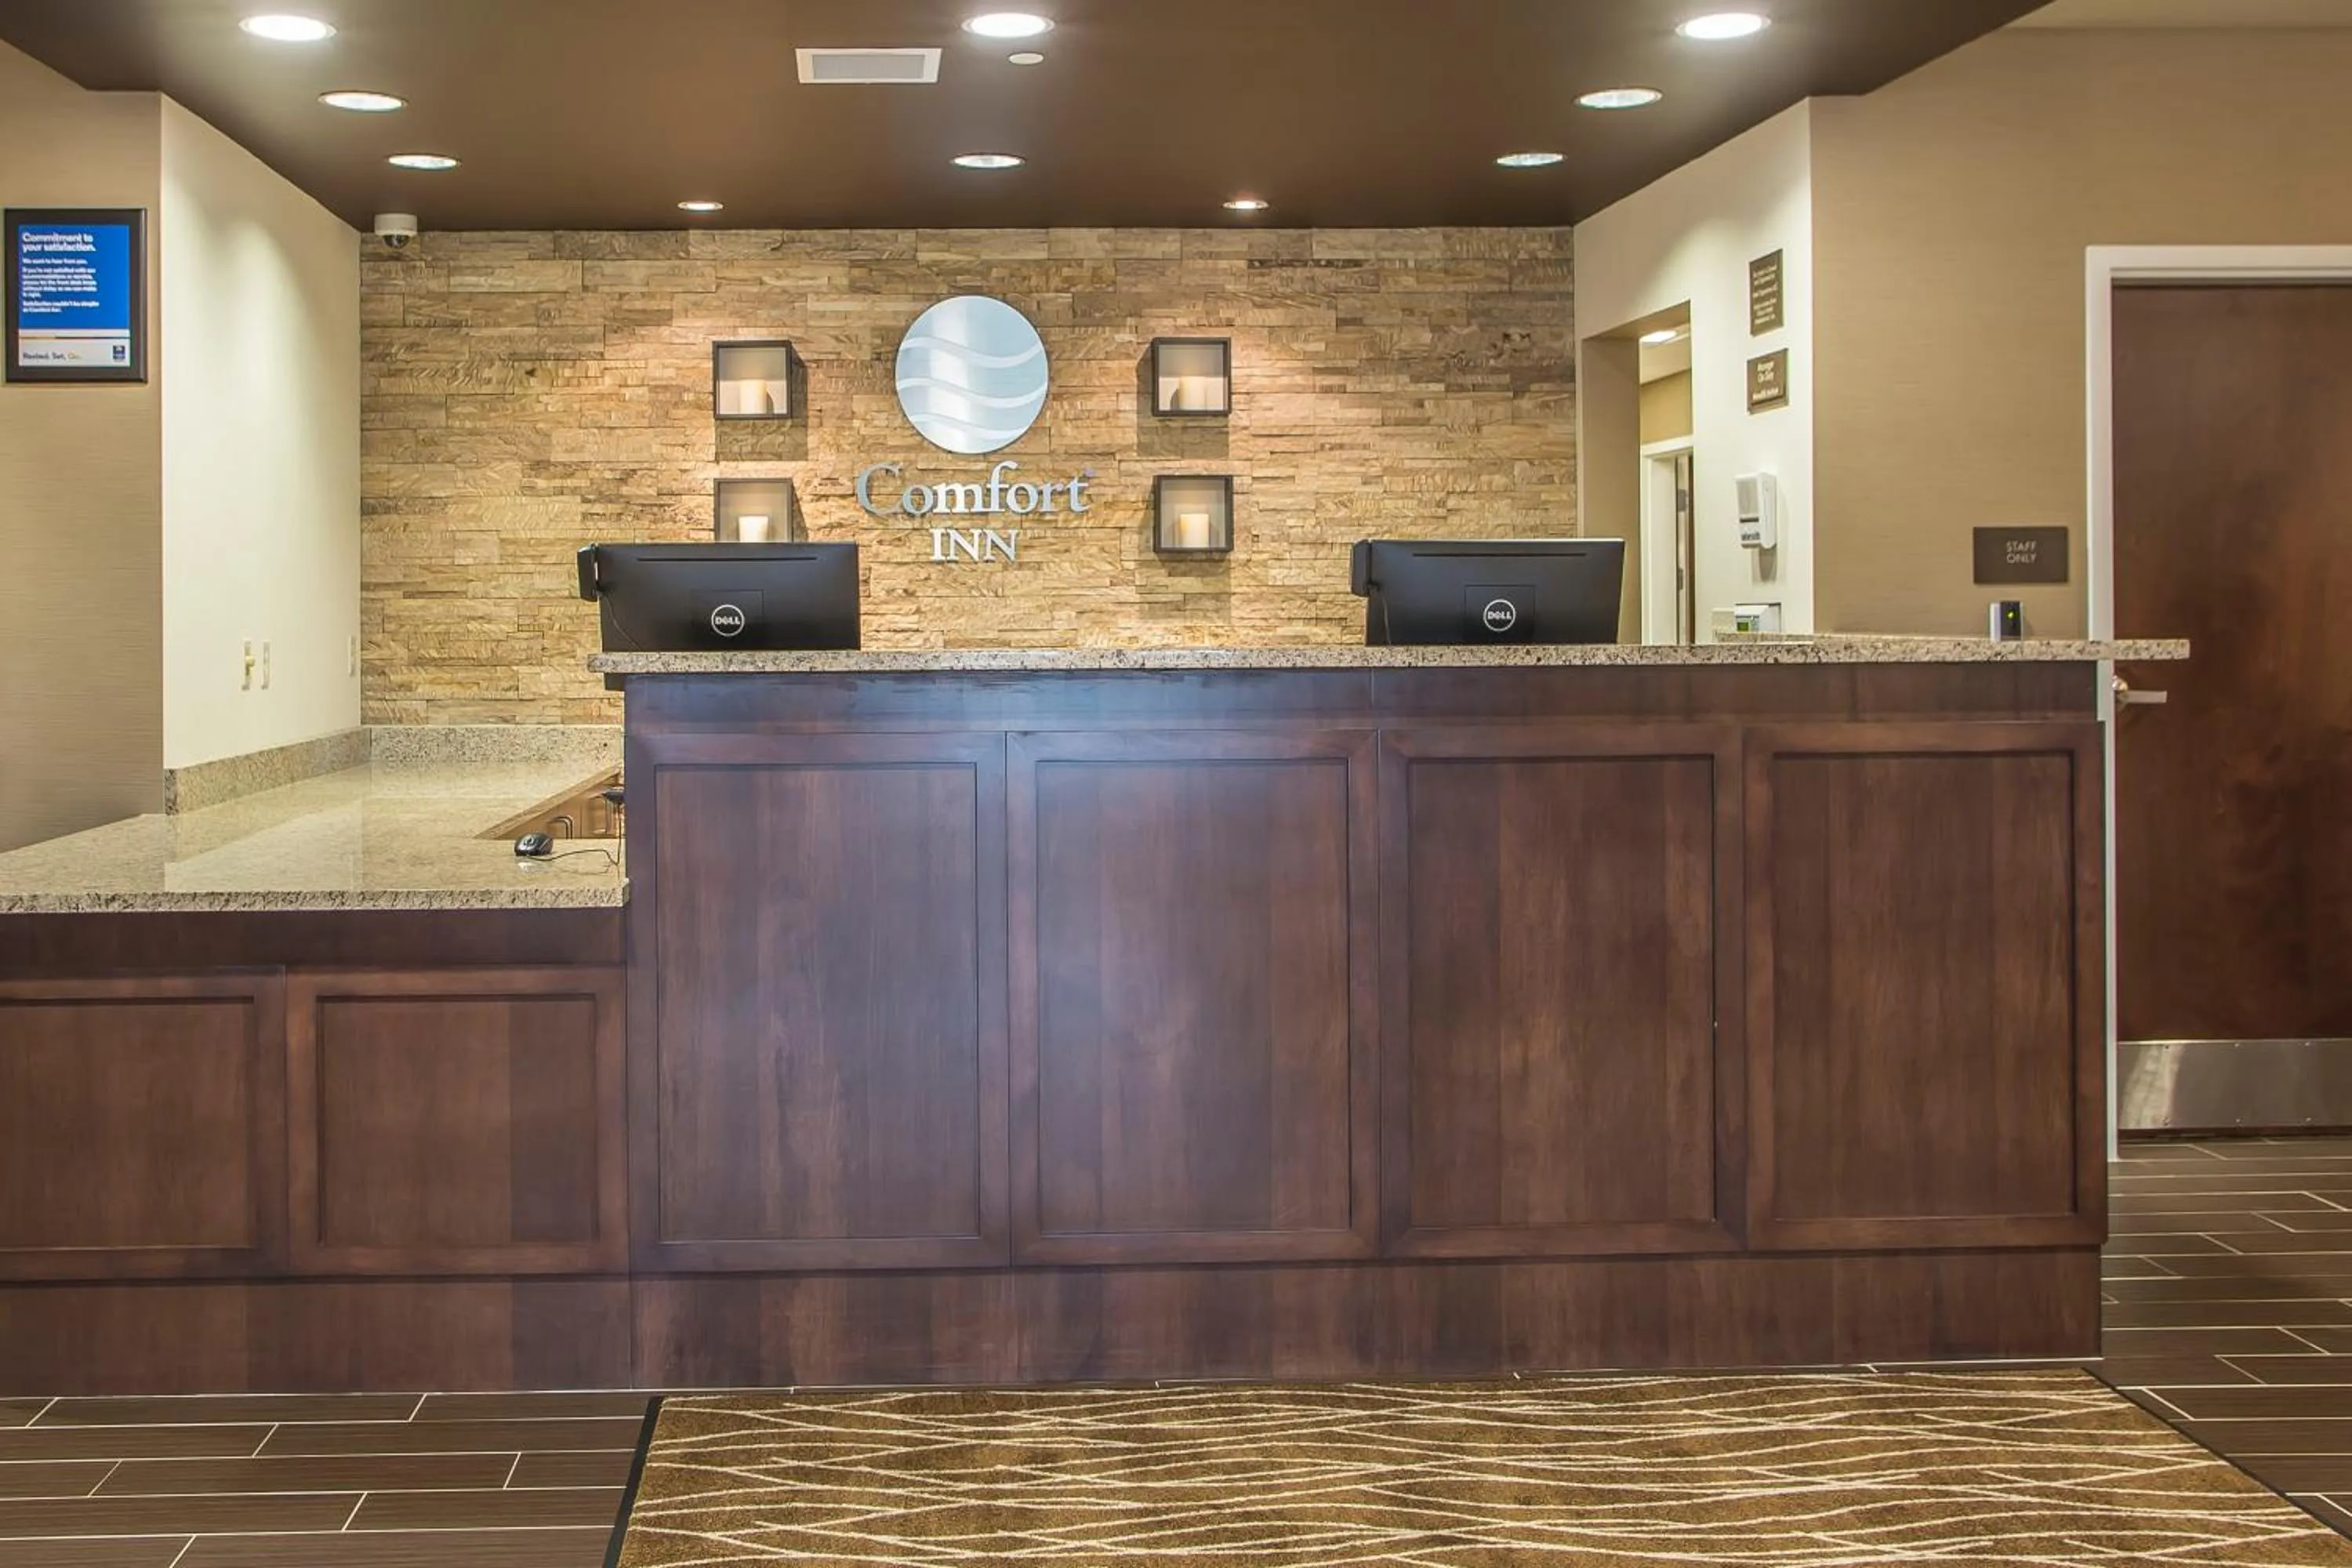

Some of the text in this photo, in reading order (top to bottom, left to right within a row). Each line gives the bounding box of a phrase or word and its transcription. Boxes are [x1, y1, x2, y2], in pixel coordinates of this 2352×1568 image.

[82, 233, 94, 242] to
[23, 243, 43, 253] your
[856, 459, 1090, 517] Comfort
[929, 528, 1019, 563] INN
[2006, 540, 2036, 552] STAFF
[2006, 553, 2036, 564] ONLY
[714, 615, 741, 625] DELL
[1487, 611, 1512, 620] DELL
